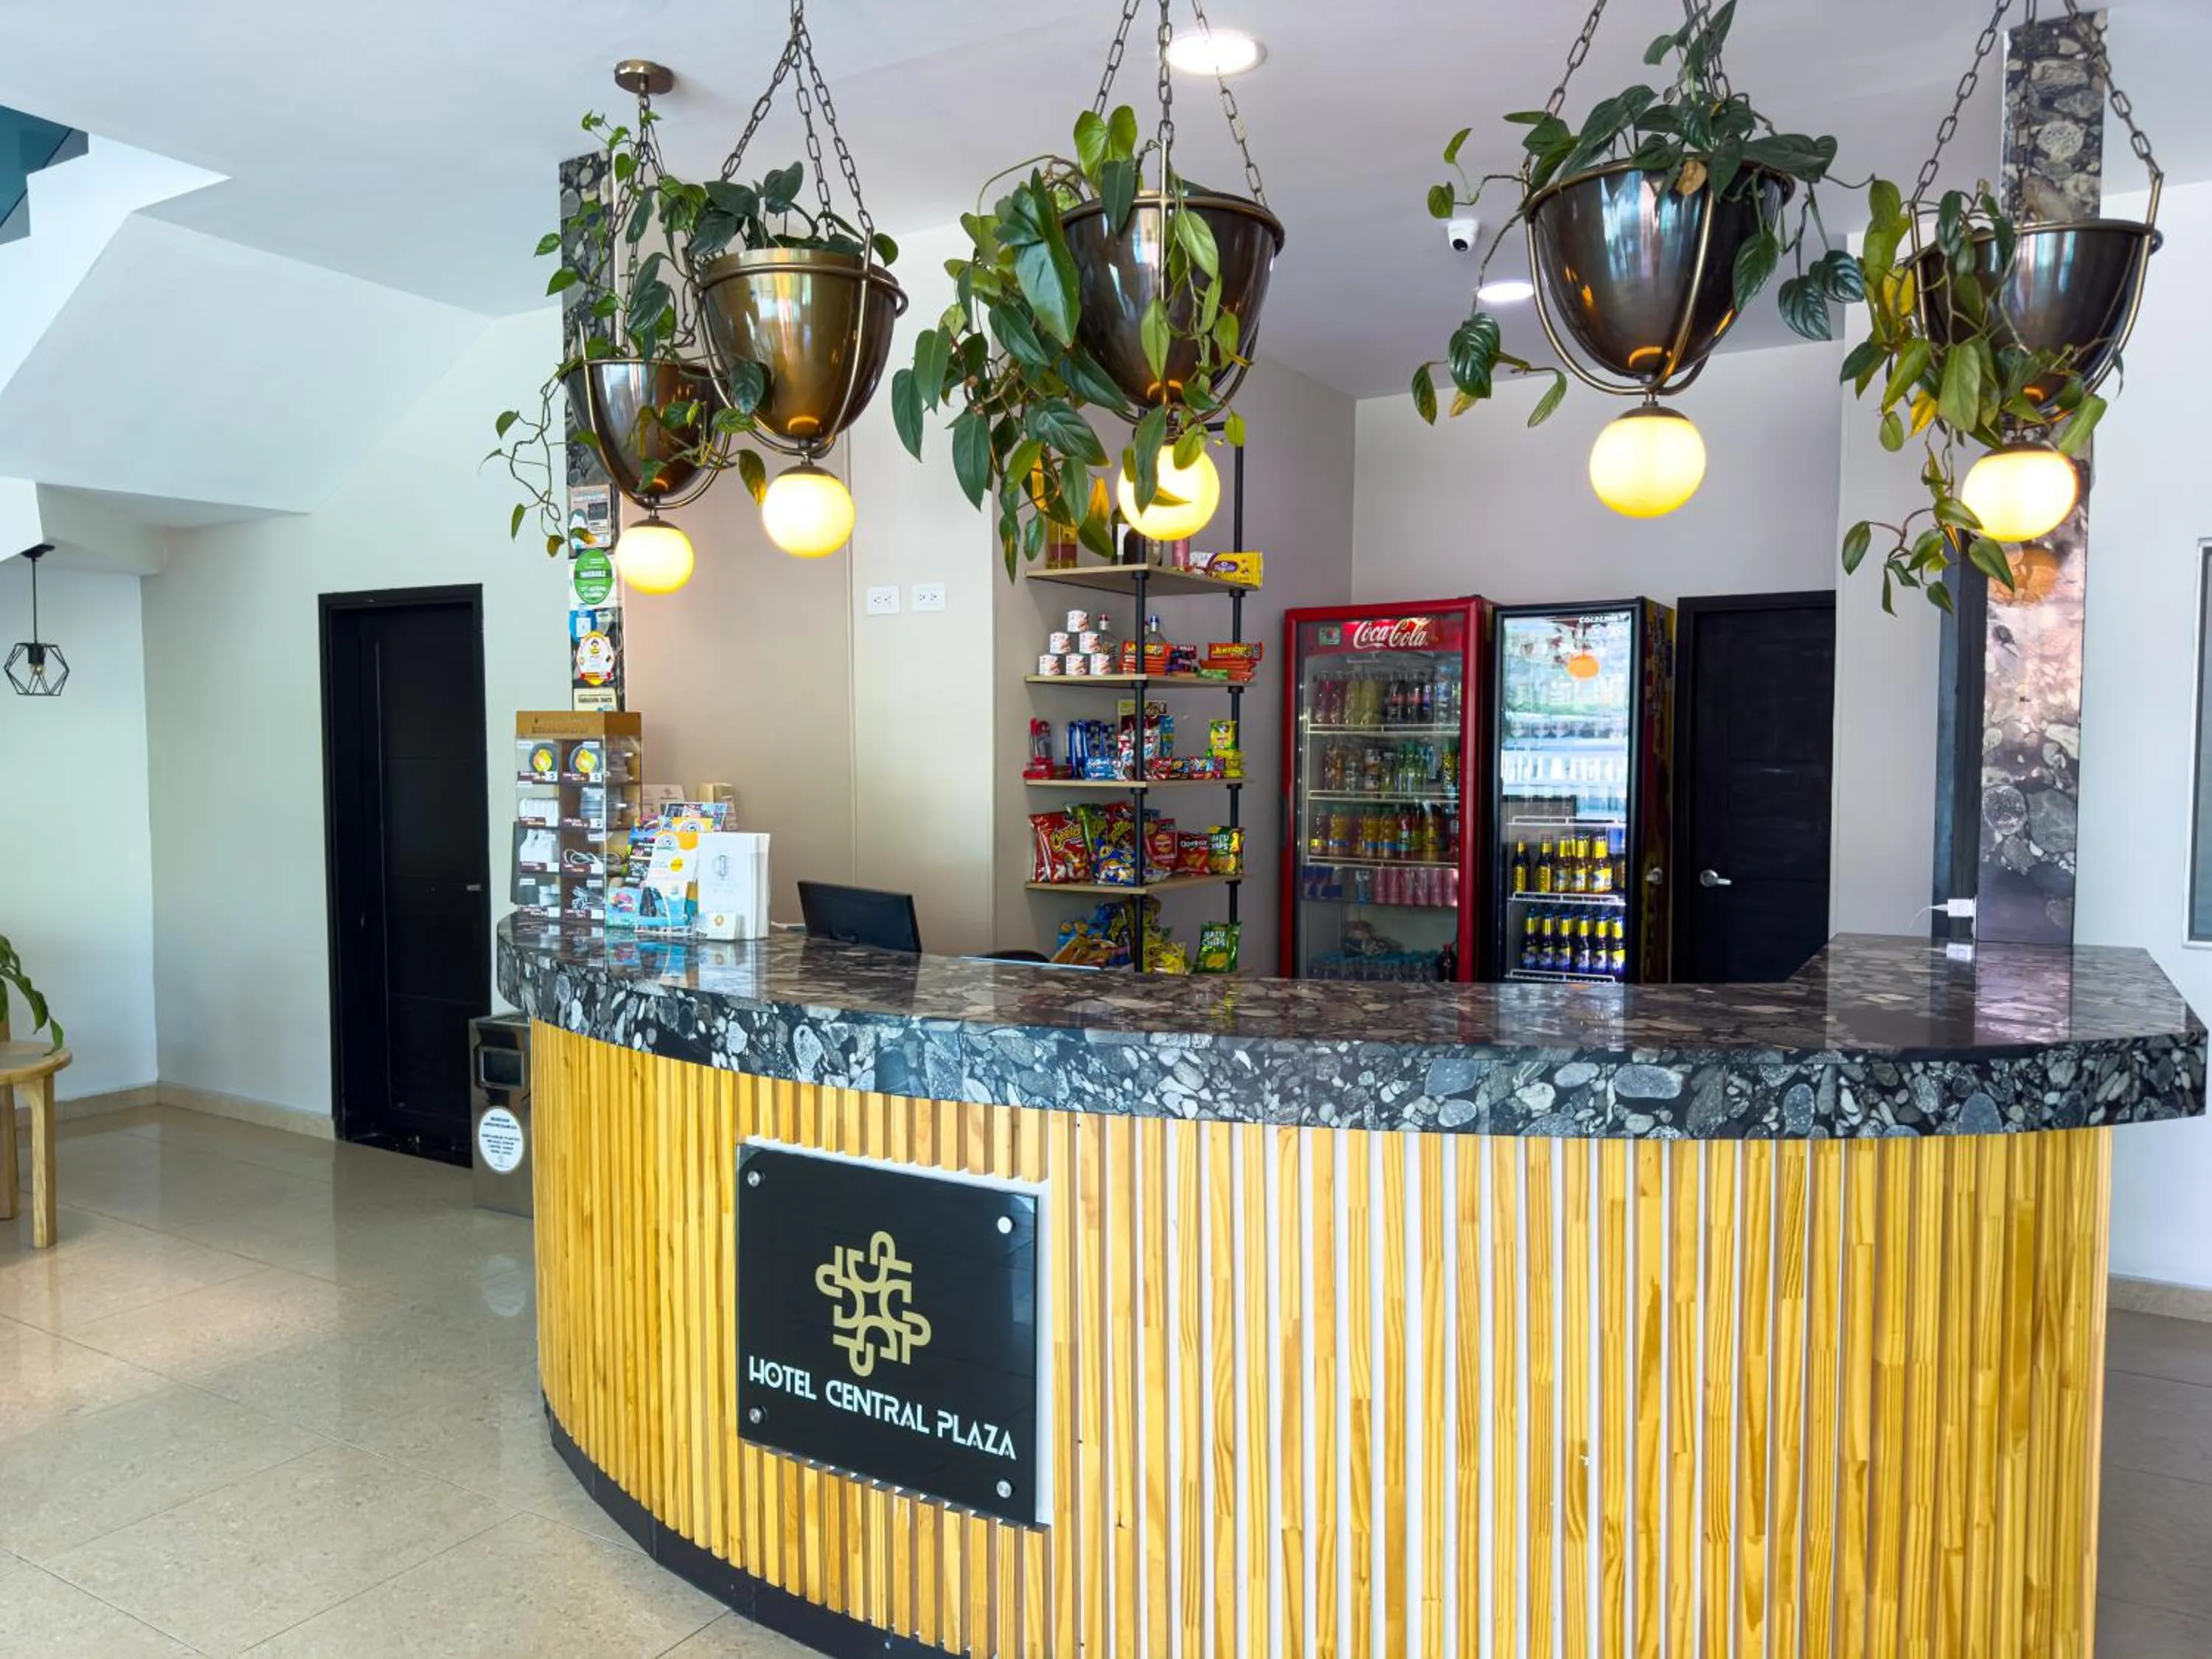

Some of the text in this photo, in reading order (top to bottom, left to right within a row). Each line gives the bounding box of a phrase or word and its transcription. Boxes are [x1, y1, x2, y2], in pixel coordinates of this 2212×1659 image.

[1354, 618, 1429, 649] Coca-Cola
[748, 1355, 1018, 1461] HOTEL CENTRAL PLAZA
